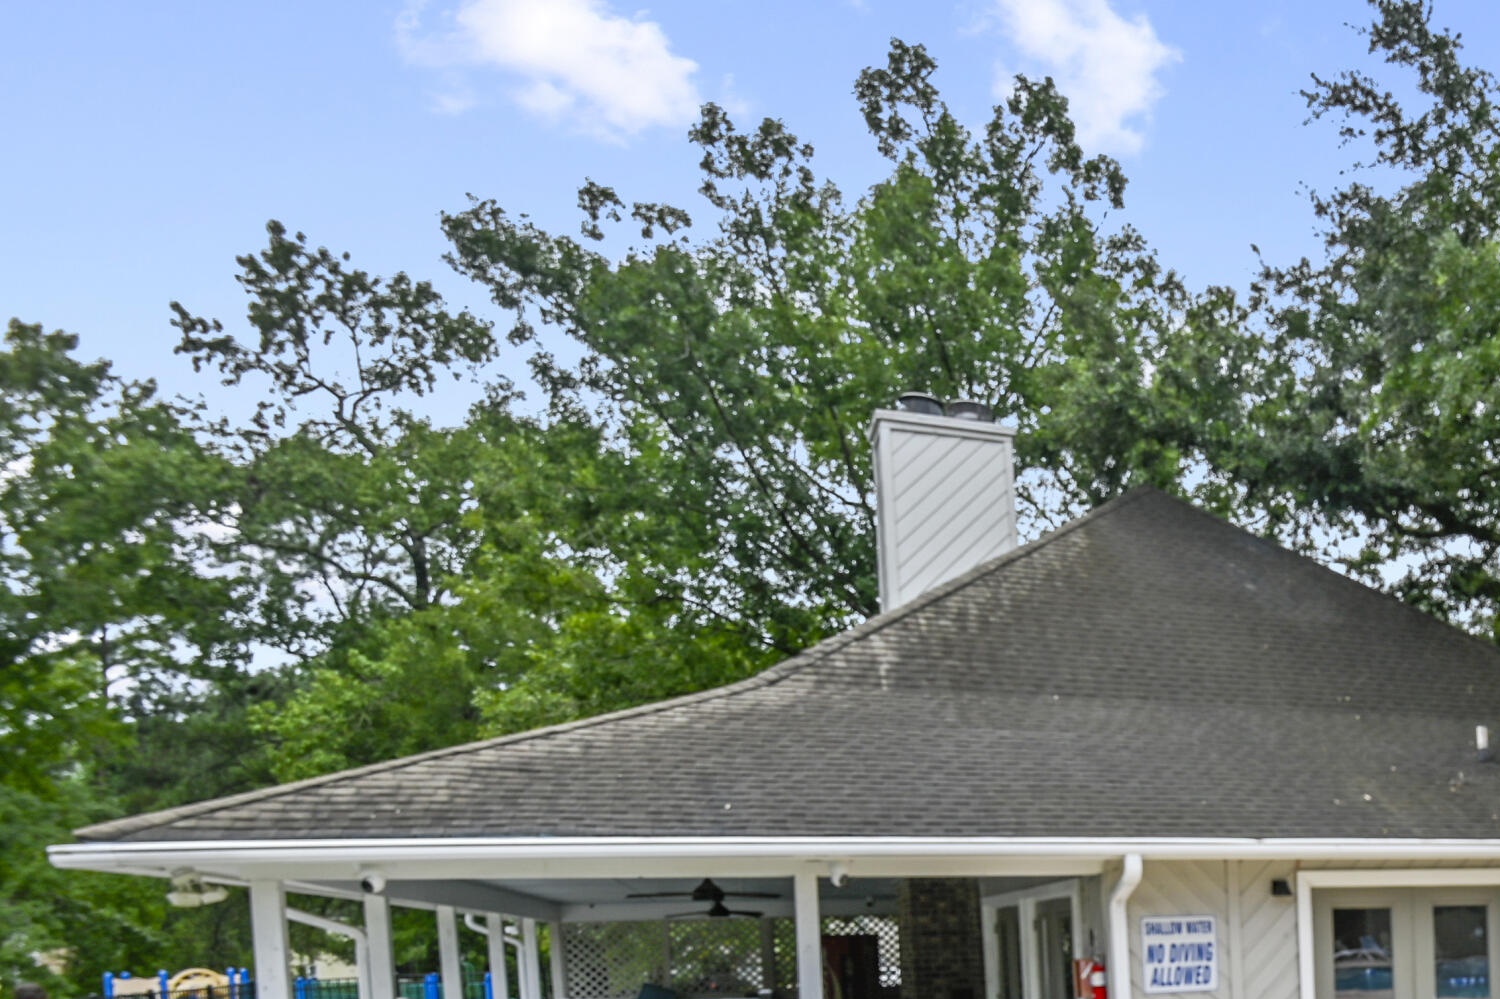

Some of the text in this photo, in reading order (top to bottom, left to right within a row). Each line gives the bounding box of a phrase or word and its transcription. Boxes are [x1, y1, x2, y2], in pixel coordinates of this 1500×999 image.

[1145, 921, 1211, 935] SHALLOW WATER
[1147, 942, 1213, 963] NO DIVING
[1150, 965, 1211, 986] ALLOWED
